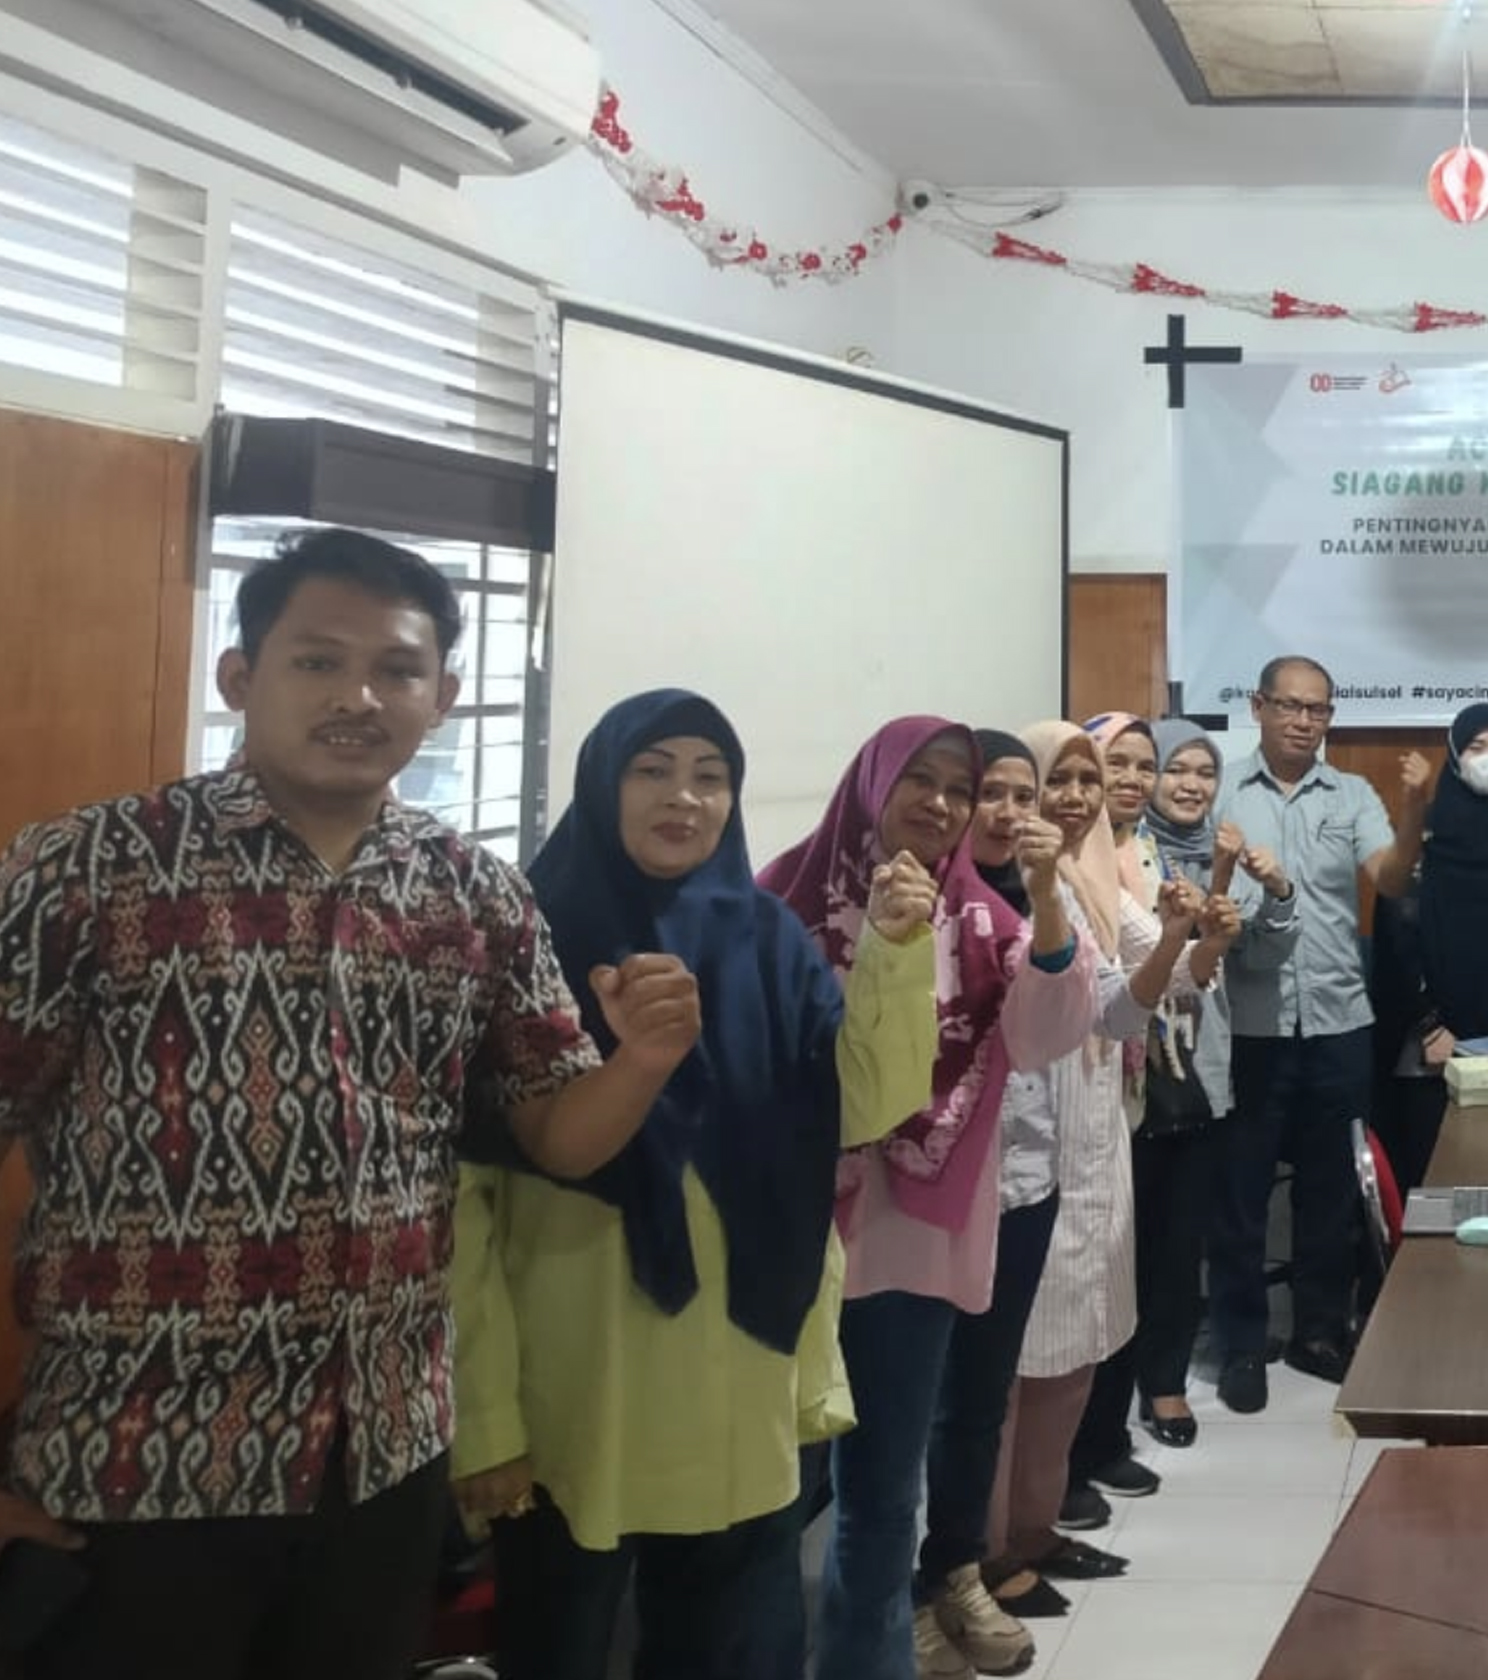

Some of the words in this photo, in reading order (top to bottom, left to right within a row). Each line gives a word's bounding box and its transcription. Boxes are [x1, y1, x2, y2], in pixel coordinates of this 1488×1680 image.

[1331, 470, 1465, 497] SIAGANG
[1353, 516, 1487, 534] PENTINGNYA
[1320, 538, 1394, 556] DALAM
